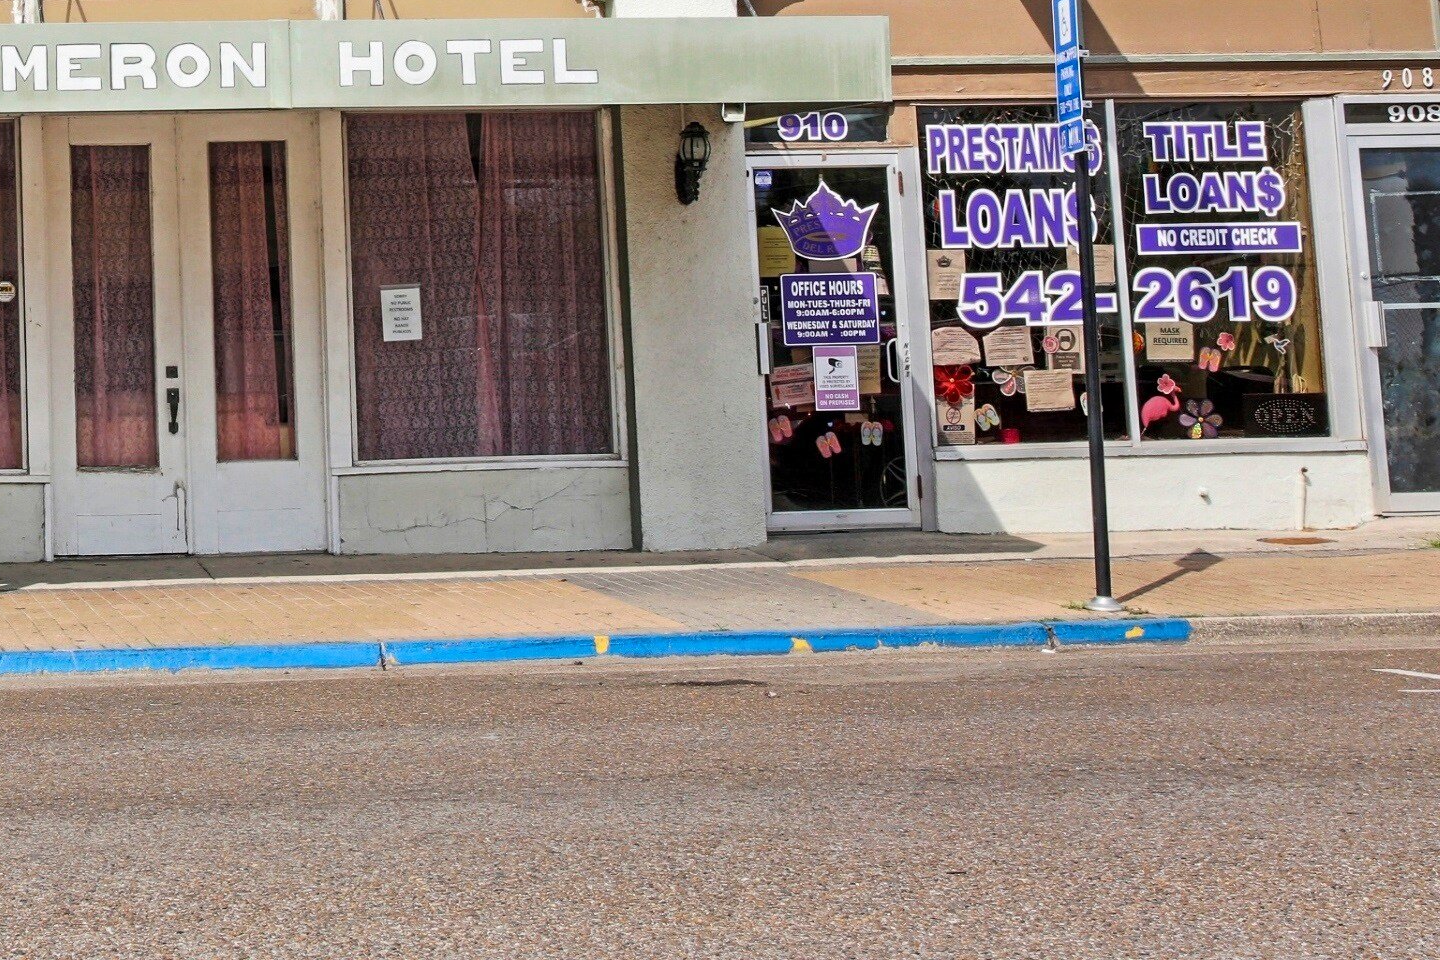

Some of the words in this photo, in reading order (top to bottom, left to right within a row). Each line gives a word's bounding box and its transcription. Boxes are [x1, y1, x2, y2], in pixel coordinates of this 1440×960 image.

[338, 38, 600, 87] HOTEL
[1382, 67, 1435, 88] 908
[1388, 104, 1440, 123] 908
[777, 111, 849, 141] 910
[1143, 121, 1267, 162] TITLE
[1157, 229, 1177, 247] NO
[1180, 229, 1228, 247] CREDIT
[1231, 227, 1278, 246] CHECK
[791, 281, 827, 297] OFFICE
[828, 280, 864, 296] HOURS
[1133, 266, 1297, 323] 2619
[787, 299, 871, 309] MON-TUES-THURS-FRI
[796, 308, 865, 317] 9:00AM-6:00PM
[786, 321, 830, 330] WEDNESDAY
[832, 321, 837, 329] &
[839, 320, 876, 328] SATURDAY
[1160, 327, 1180, 335] MASK
[1153, 337, 1188, 345] REQUIRED
[1255, 406, 1315, 424] OPEN
